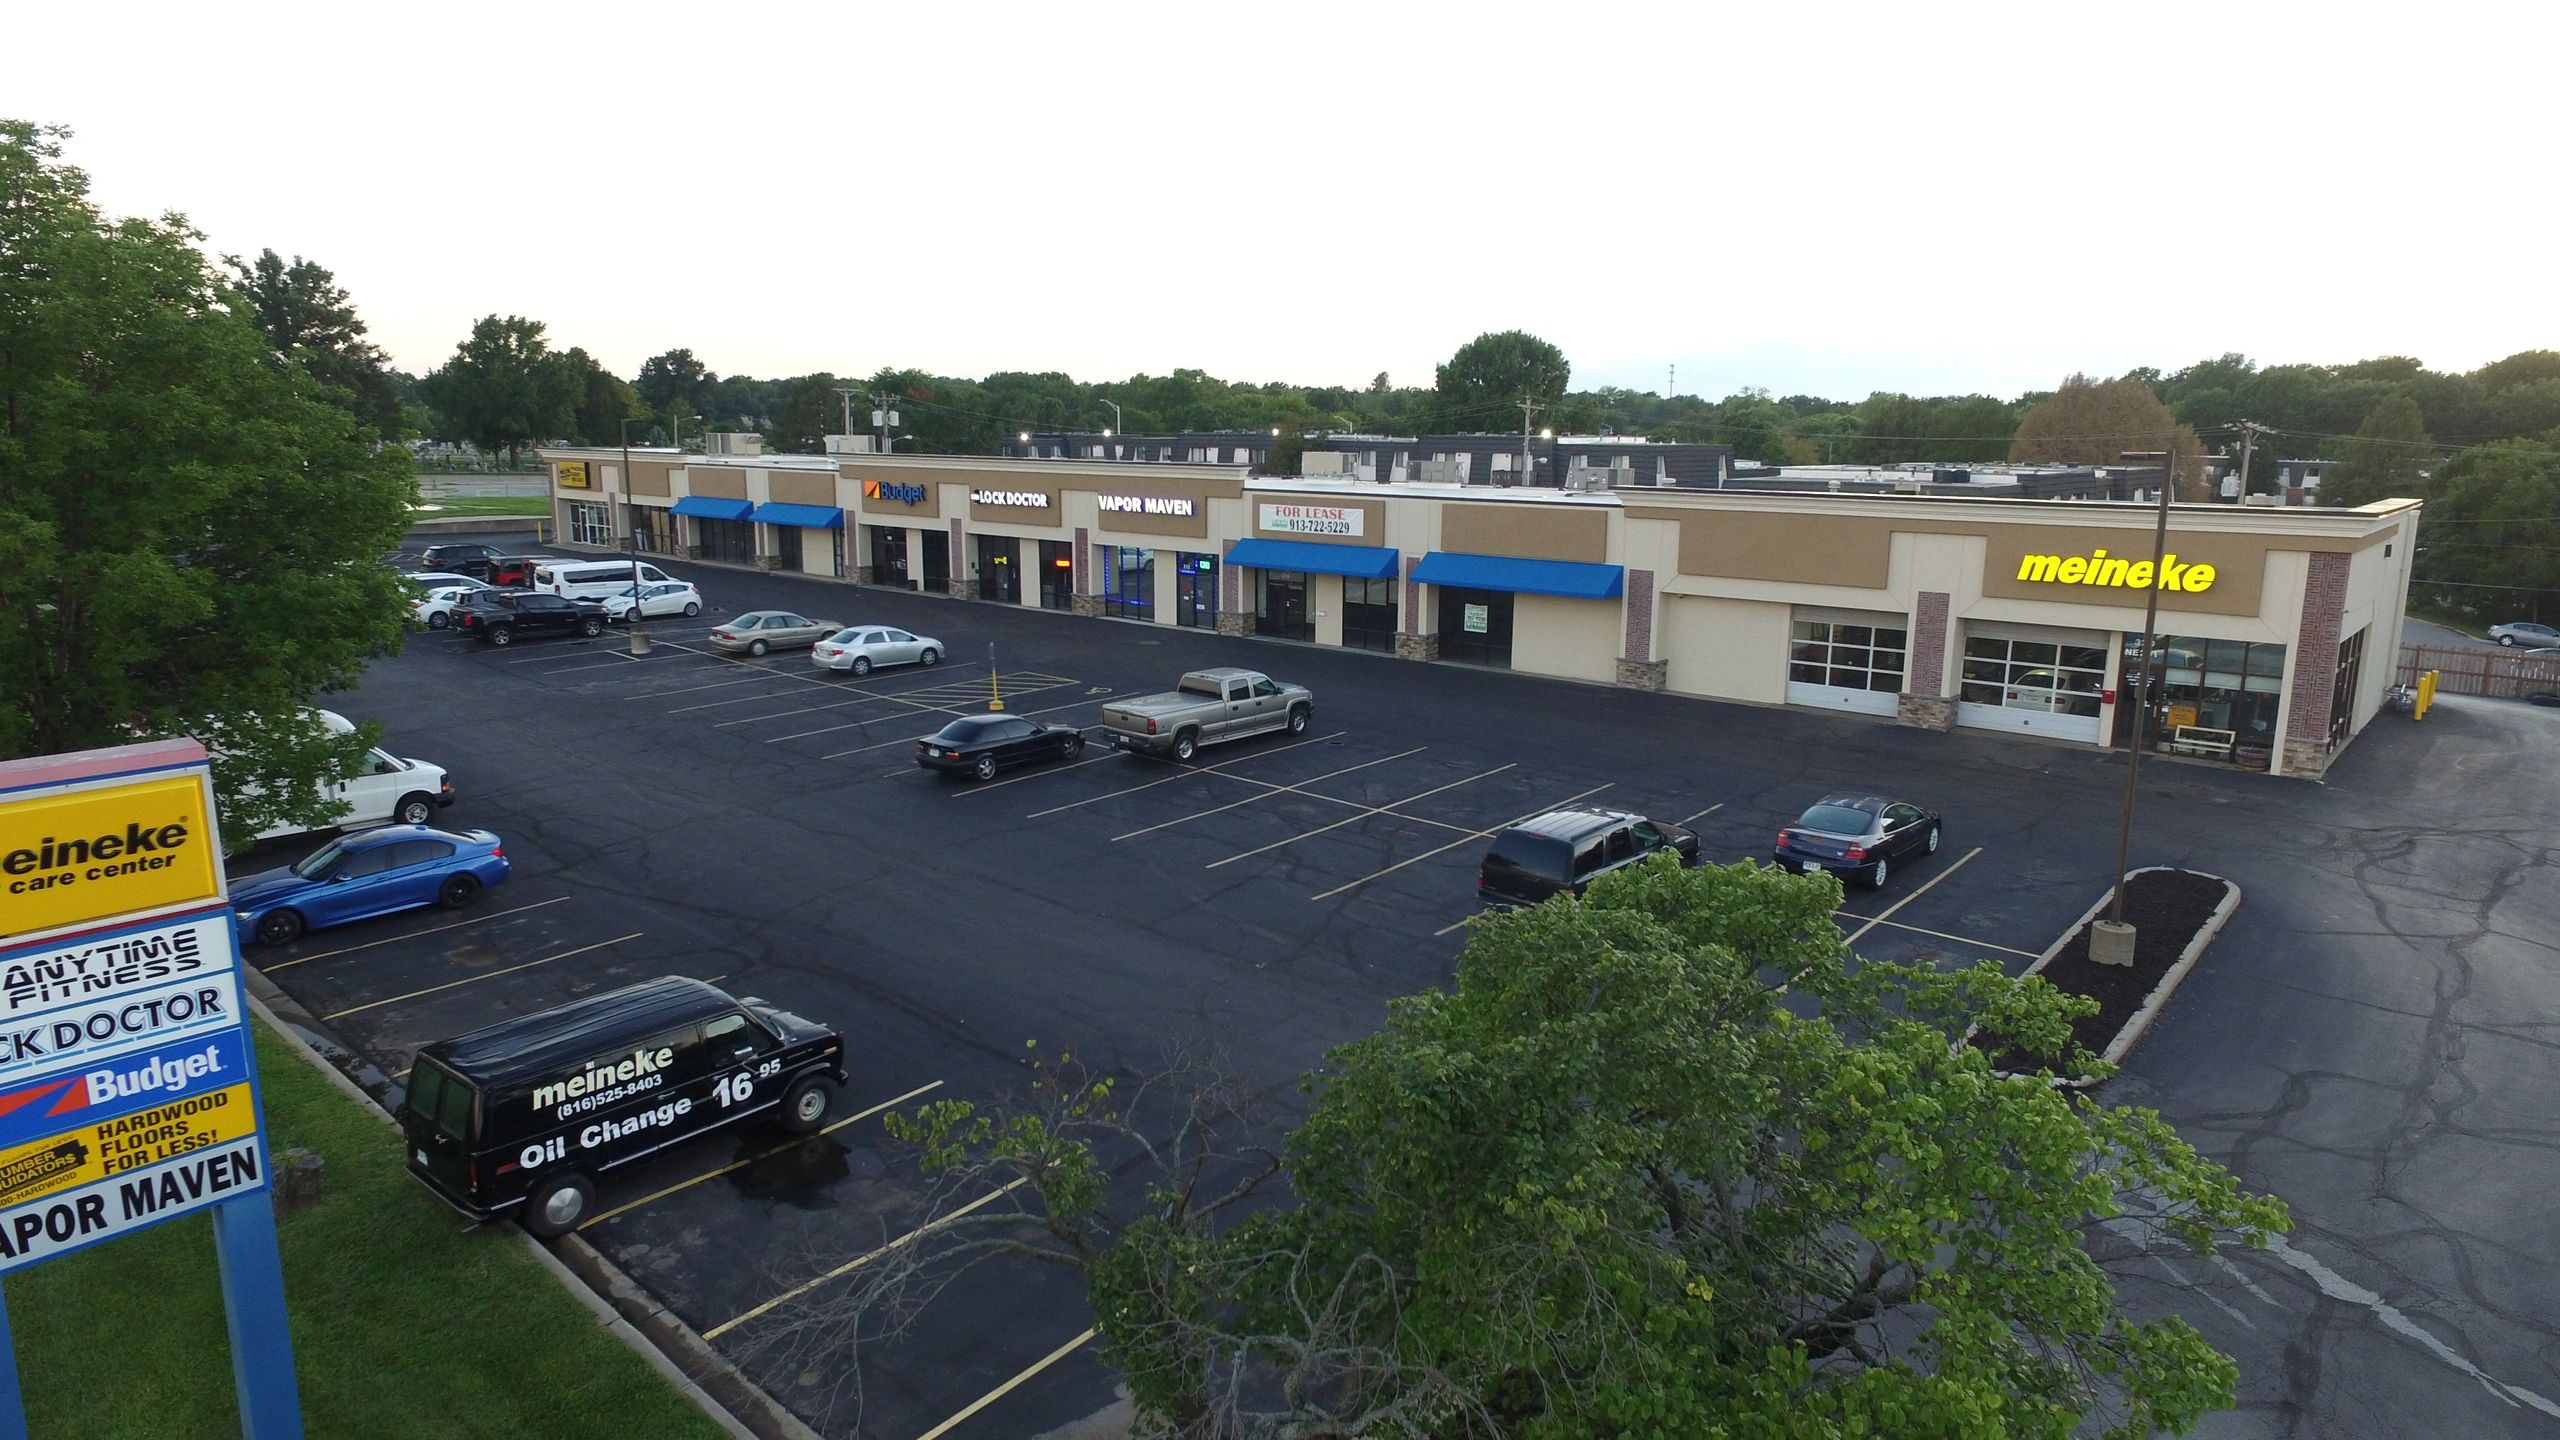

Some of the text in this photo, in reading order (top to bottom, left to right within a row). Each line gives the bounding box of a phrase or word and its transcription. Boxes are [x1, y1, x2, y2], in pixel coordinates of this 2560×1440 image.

[880, 482, 926, 506] Budget
[979, 490, 1048, 507] LOCK DOCTOR
[1098, 495, 1192, 515] VAPOR MAVEN
[1275, 506, 1346, 520] FOR LEASE
[1289, 519, 1350, 534] 913-722-5229
[2016, 549, 2216, 592] meineke
[9, 854, 176, 894] care center
[3, 928, 198, 991] ANYTIME
[9, 951, 201, 1010] FITNESS
[53, 988, 222, 1050] DOCTOR
[85, 1044, 223, 1106] Budget
[533, 1047, 673, 1111] meineke
[557, 1073, 663, 1121] (816)525-8403
[97, 1092, 228, 1141] HARDWOOD
[519, 1058, 781, 1169] Oil Change 16 95
[100, 1120, 189, 1159] FLOORS
[103, 1128, 218, 1176] FOR LESS!
[0, 1153, 76, 1190] UIDATORS
[120, 1146, 258, 1221] MAVEN
